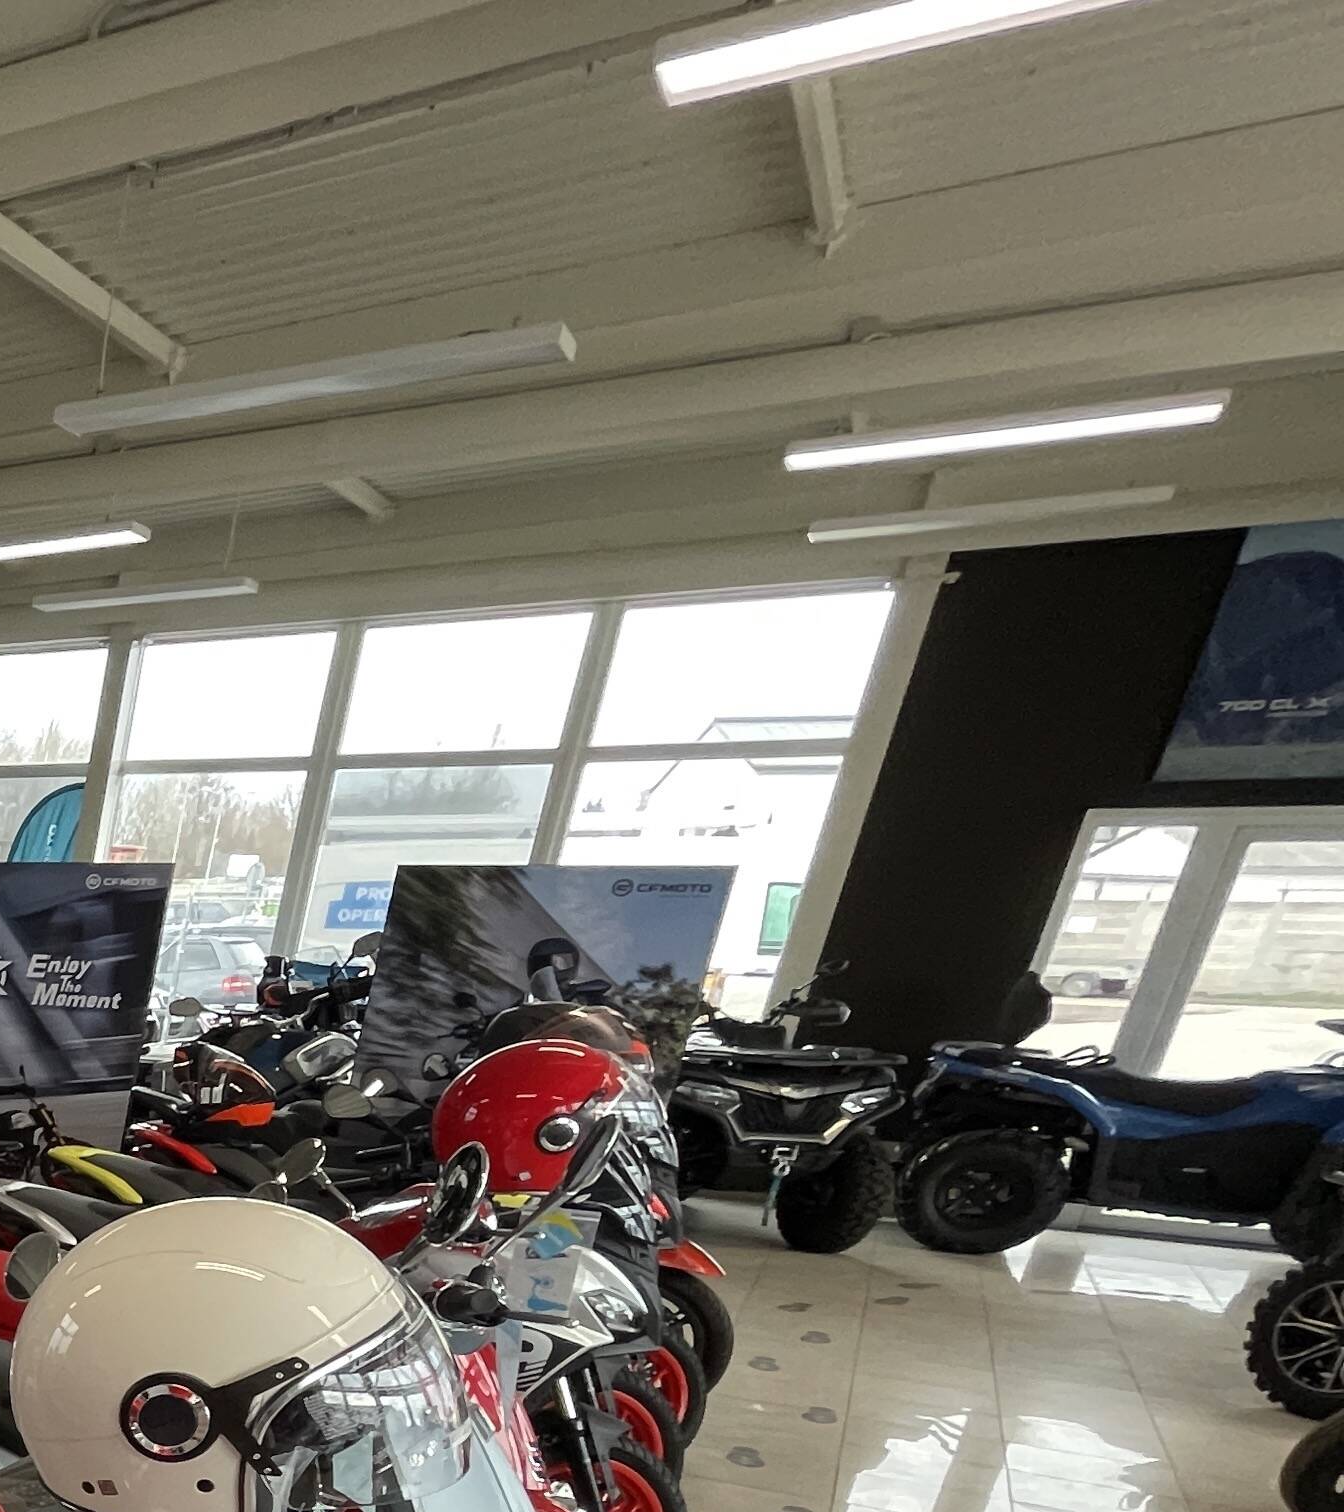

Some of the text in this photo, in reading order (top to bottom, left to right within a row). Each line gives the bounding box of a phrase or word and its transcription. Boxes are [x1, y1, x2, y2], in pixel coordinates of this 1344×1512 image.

[103, 877, 158, 887] CFMOTO
[636, 883, 712, 894] CFMOTO
[26, 953, 94, 979] Enjoy
[60, 974, 82, 993] The
[31, 982, 123, 1010] Moment
